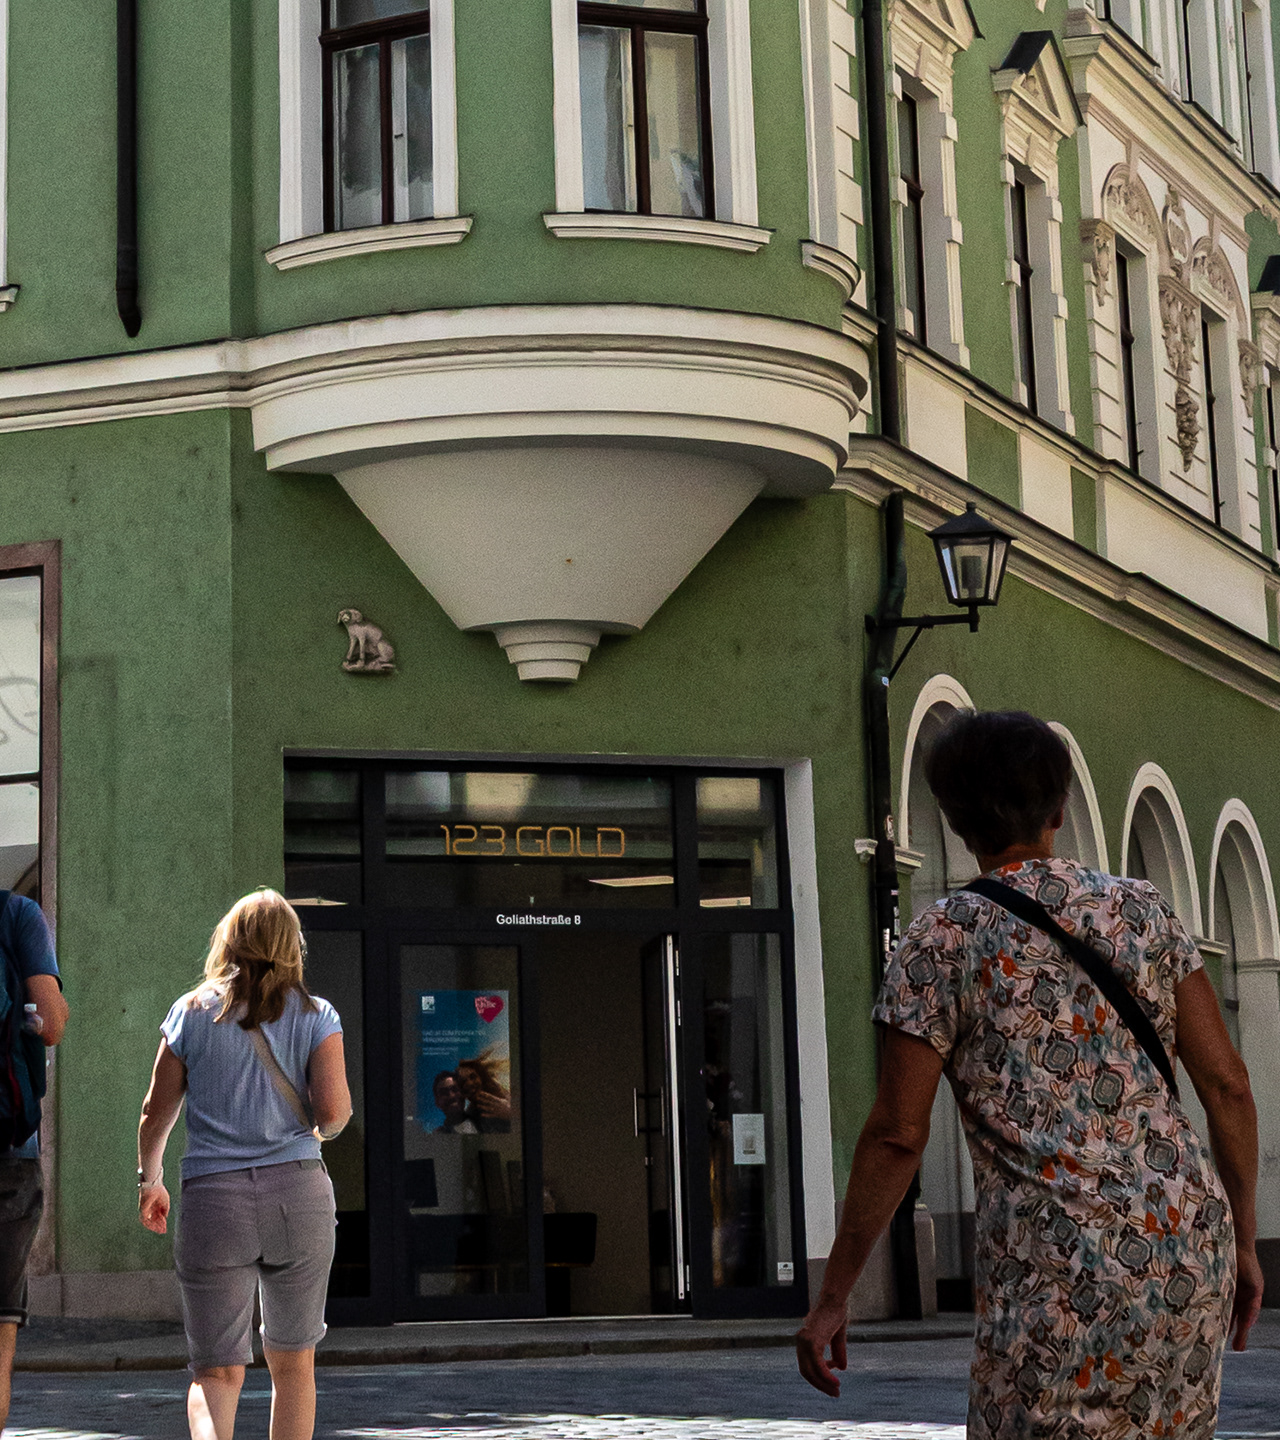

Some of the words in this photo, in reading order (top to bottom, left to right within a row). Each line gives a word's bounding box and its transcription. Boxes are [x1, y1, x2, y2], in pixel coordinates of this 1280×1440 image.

[440, 824, 506, 855] 123
[516, 826, 625, 857] GOLD
[496, 914, 571, 925] Goliathstraße
[574, 915, 581, 925] 8
